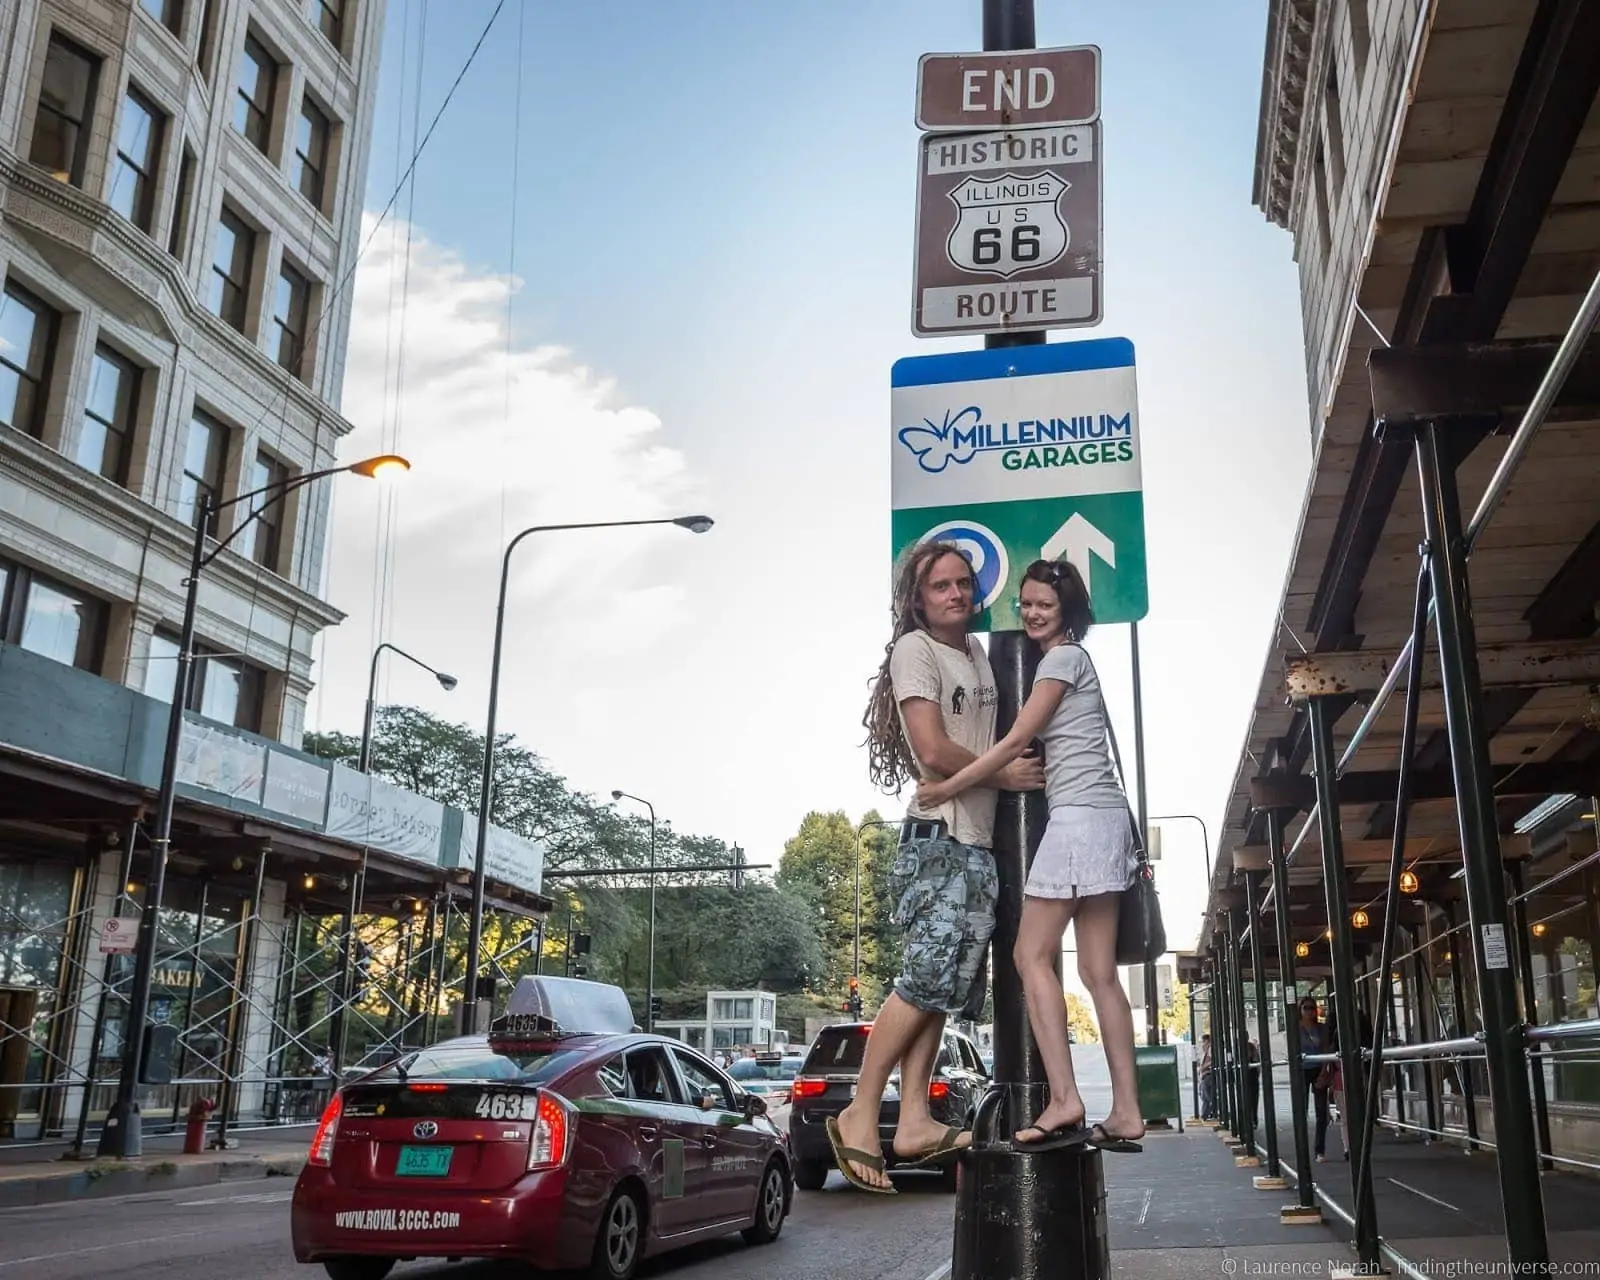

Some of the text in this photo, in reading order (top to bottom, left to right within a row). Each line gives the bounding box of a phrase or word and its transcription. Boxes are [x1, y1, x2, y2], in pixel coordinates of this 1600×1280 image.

[962, 67, 1055, 112] END
[940, 134, 1078, 167] HISTORIC
[967, 183, 1050, 201] ILLINOIS
[972, 225, 1040, 264] 66
[957, 289, 1057, 318] ROUTE
[953, 412, 1130, 449] MILLENNIUM
[1002, 441, 1133, 471] GARAGES
[507, 1014, 538, 1032] 4635
